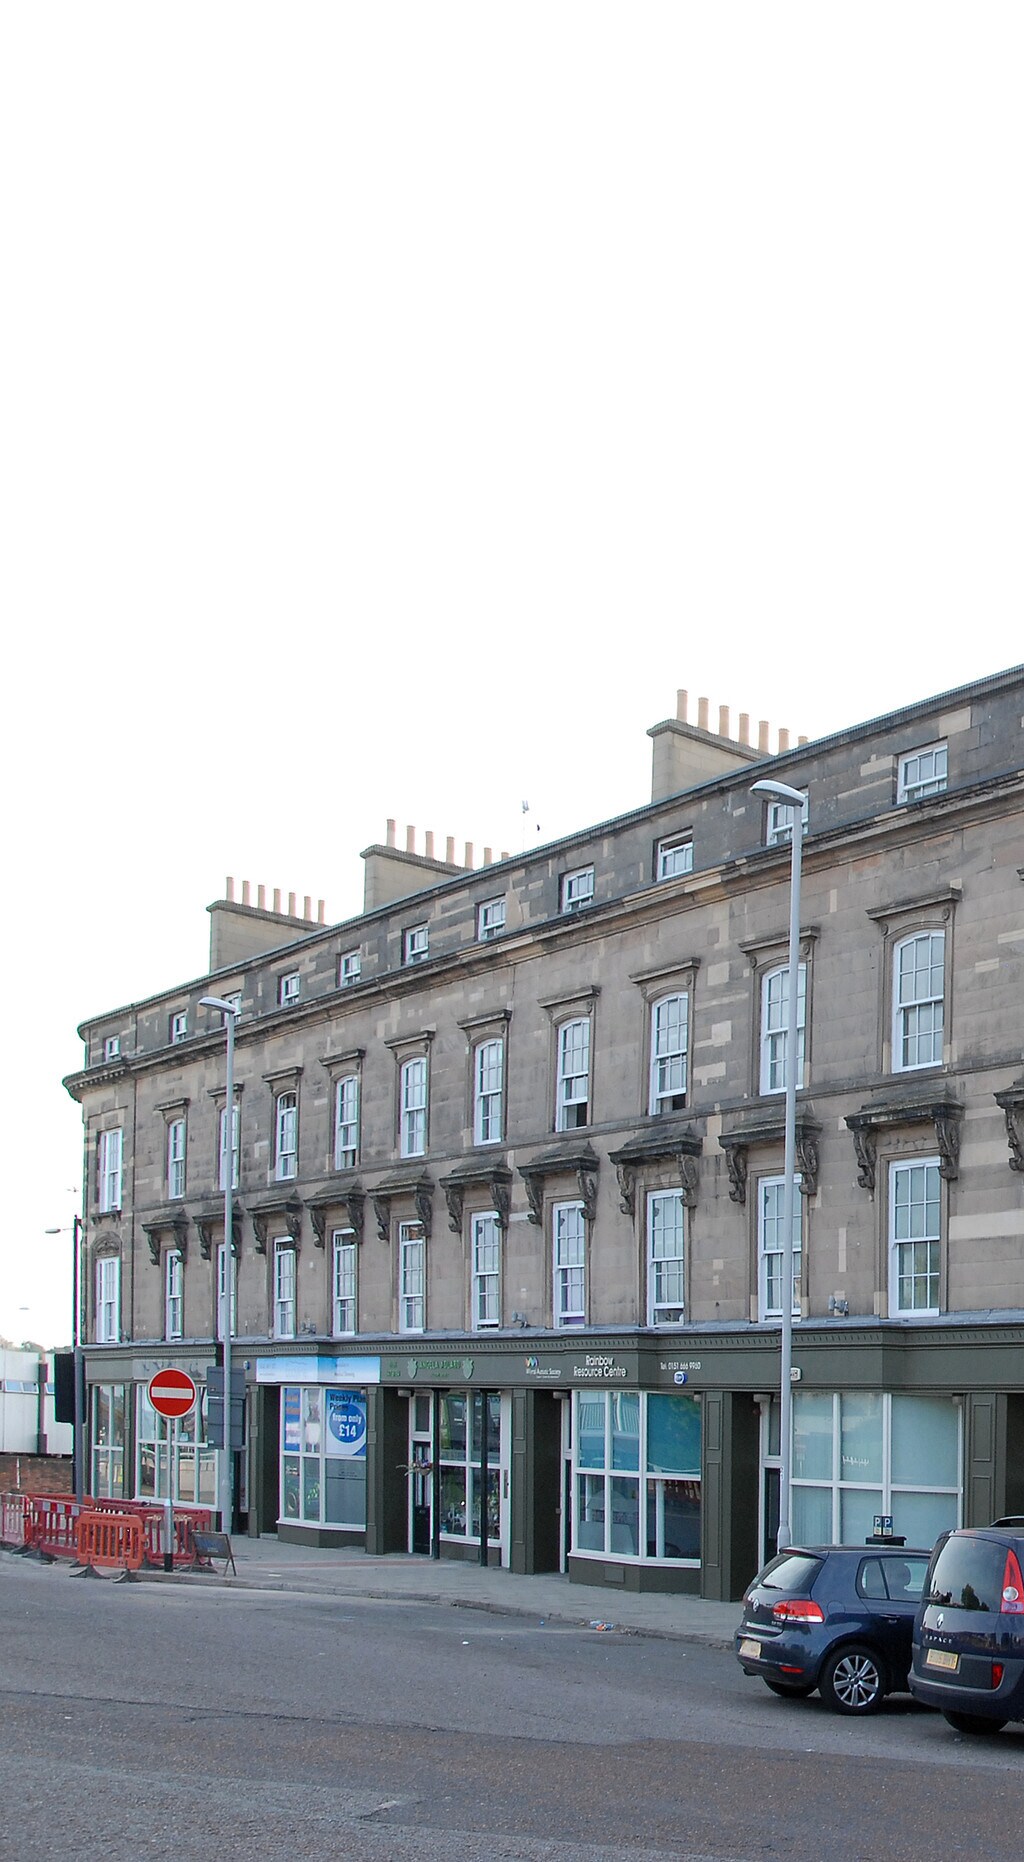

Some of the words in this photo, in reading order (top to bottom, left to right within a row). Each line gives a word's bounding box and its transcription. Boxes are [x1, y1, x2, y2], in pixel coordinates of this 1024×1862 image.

[585, 1354, 615, 1366] Rainbow
[668, 1361, 679, 1370] 0151
[573, 1366, 603, 1377] Resource
[603, 1366, 627, 1377] Centre
[329, 1393, 351, 1403] Weekly
[332, 1413, 347, 1422] from
[348, 1414, 362, 1424] only
[339, 1424, 356, 1437] £14
[875, 1517, 880, 1527] P
[884, 1518, 890, 1527] P
